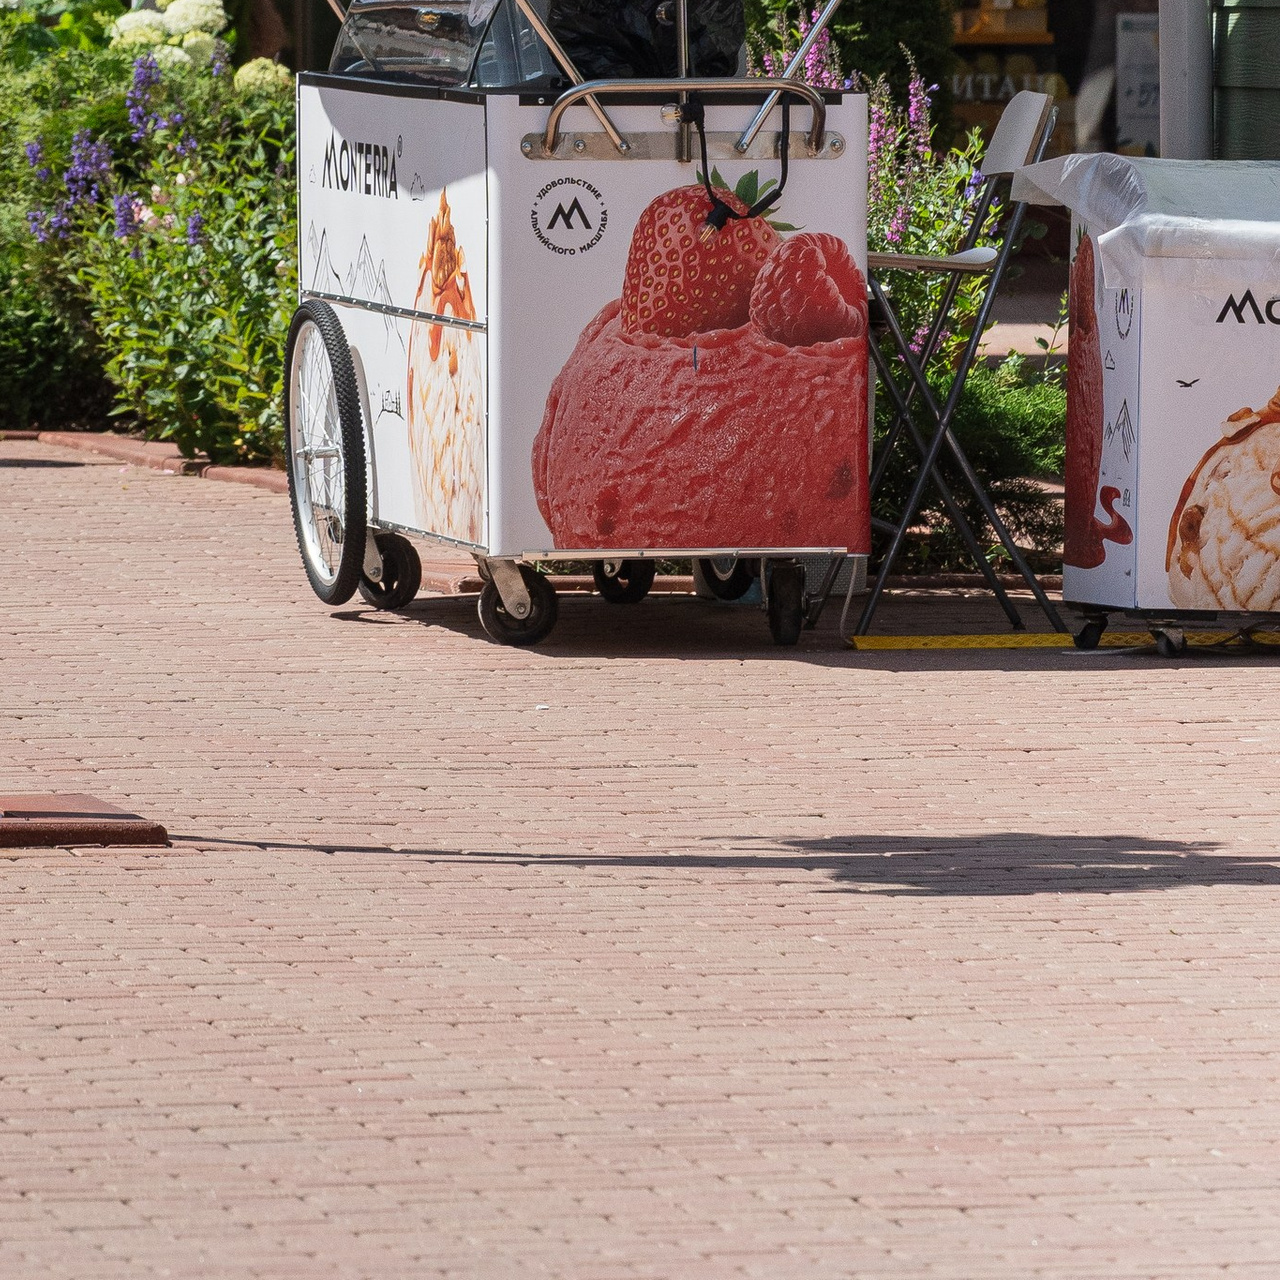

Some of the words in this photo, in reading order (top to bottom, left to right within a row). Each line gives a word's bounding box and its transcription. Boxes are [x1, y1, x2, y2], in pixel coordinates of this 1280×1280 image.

[536, 177, 602, 200] УДОВОЛЬСТВИЕ
[530, 209, 576, 256] АЛЬПИЙСКОГО
[579, 209, 608, 254] МАСШТАБА
